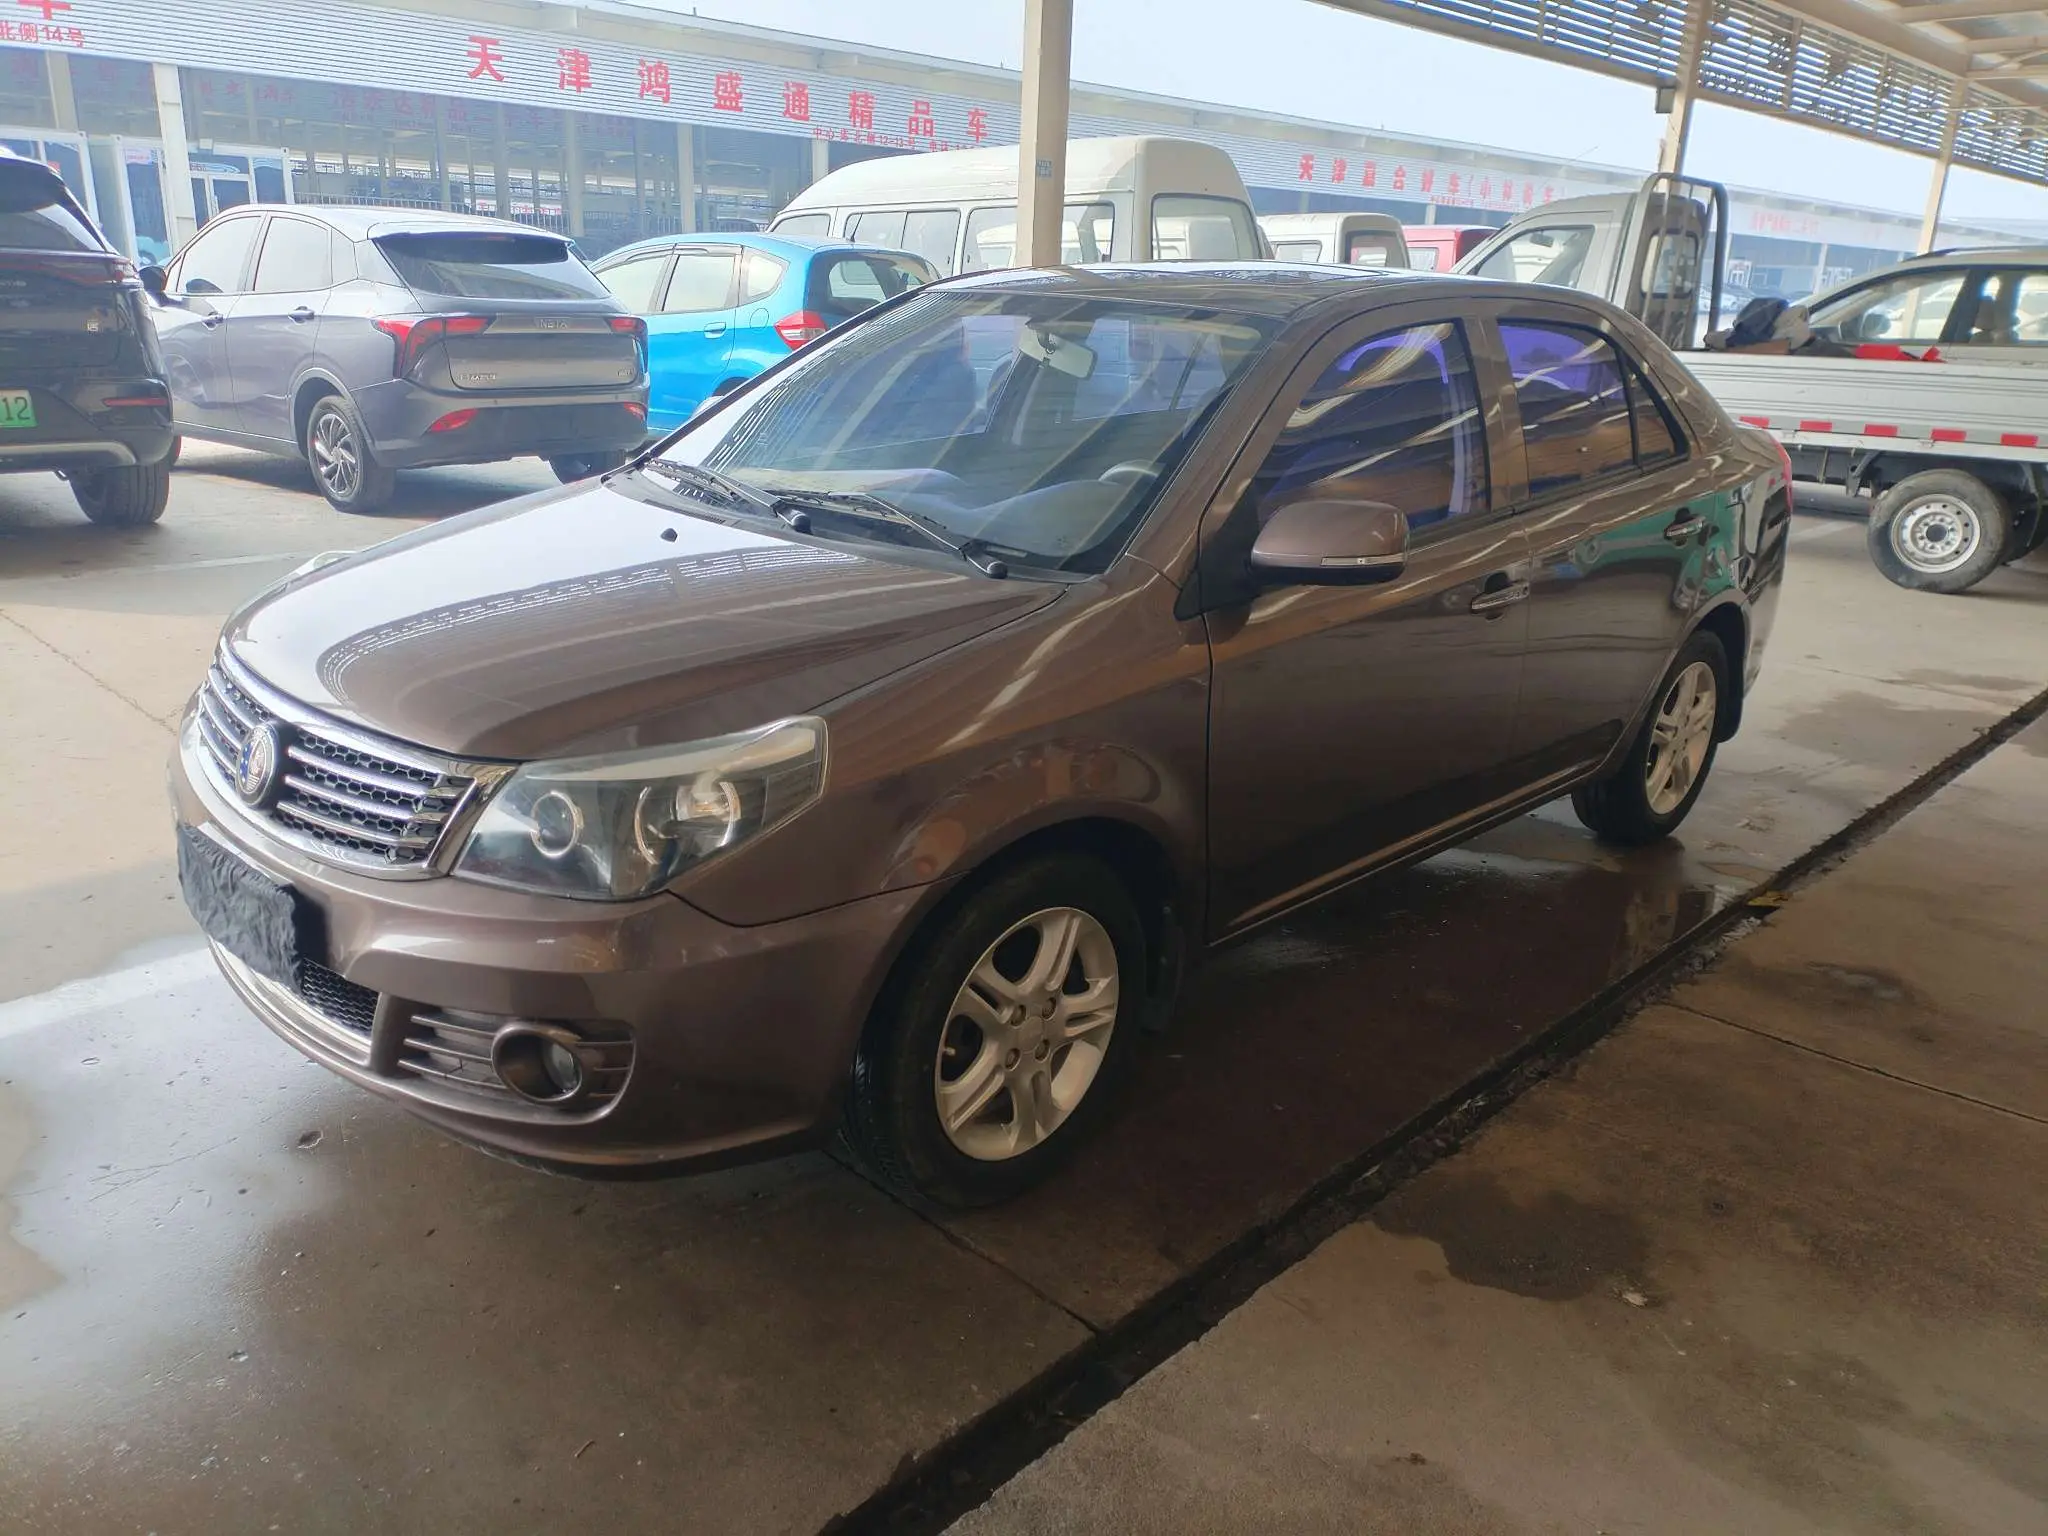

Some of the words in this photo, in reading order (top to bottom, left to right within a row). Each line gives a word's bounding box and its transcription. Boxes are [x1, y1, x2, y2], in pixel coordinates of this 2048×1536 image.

[467, 35, 989, 144] 天津鸿盛通精品车
